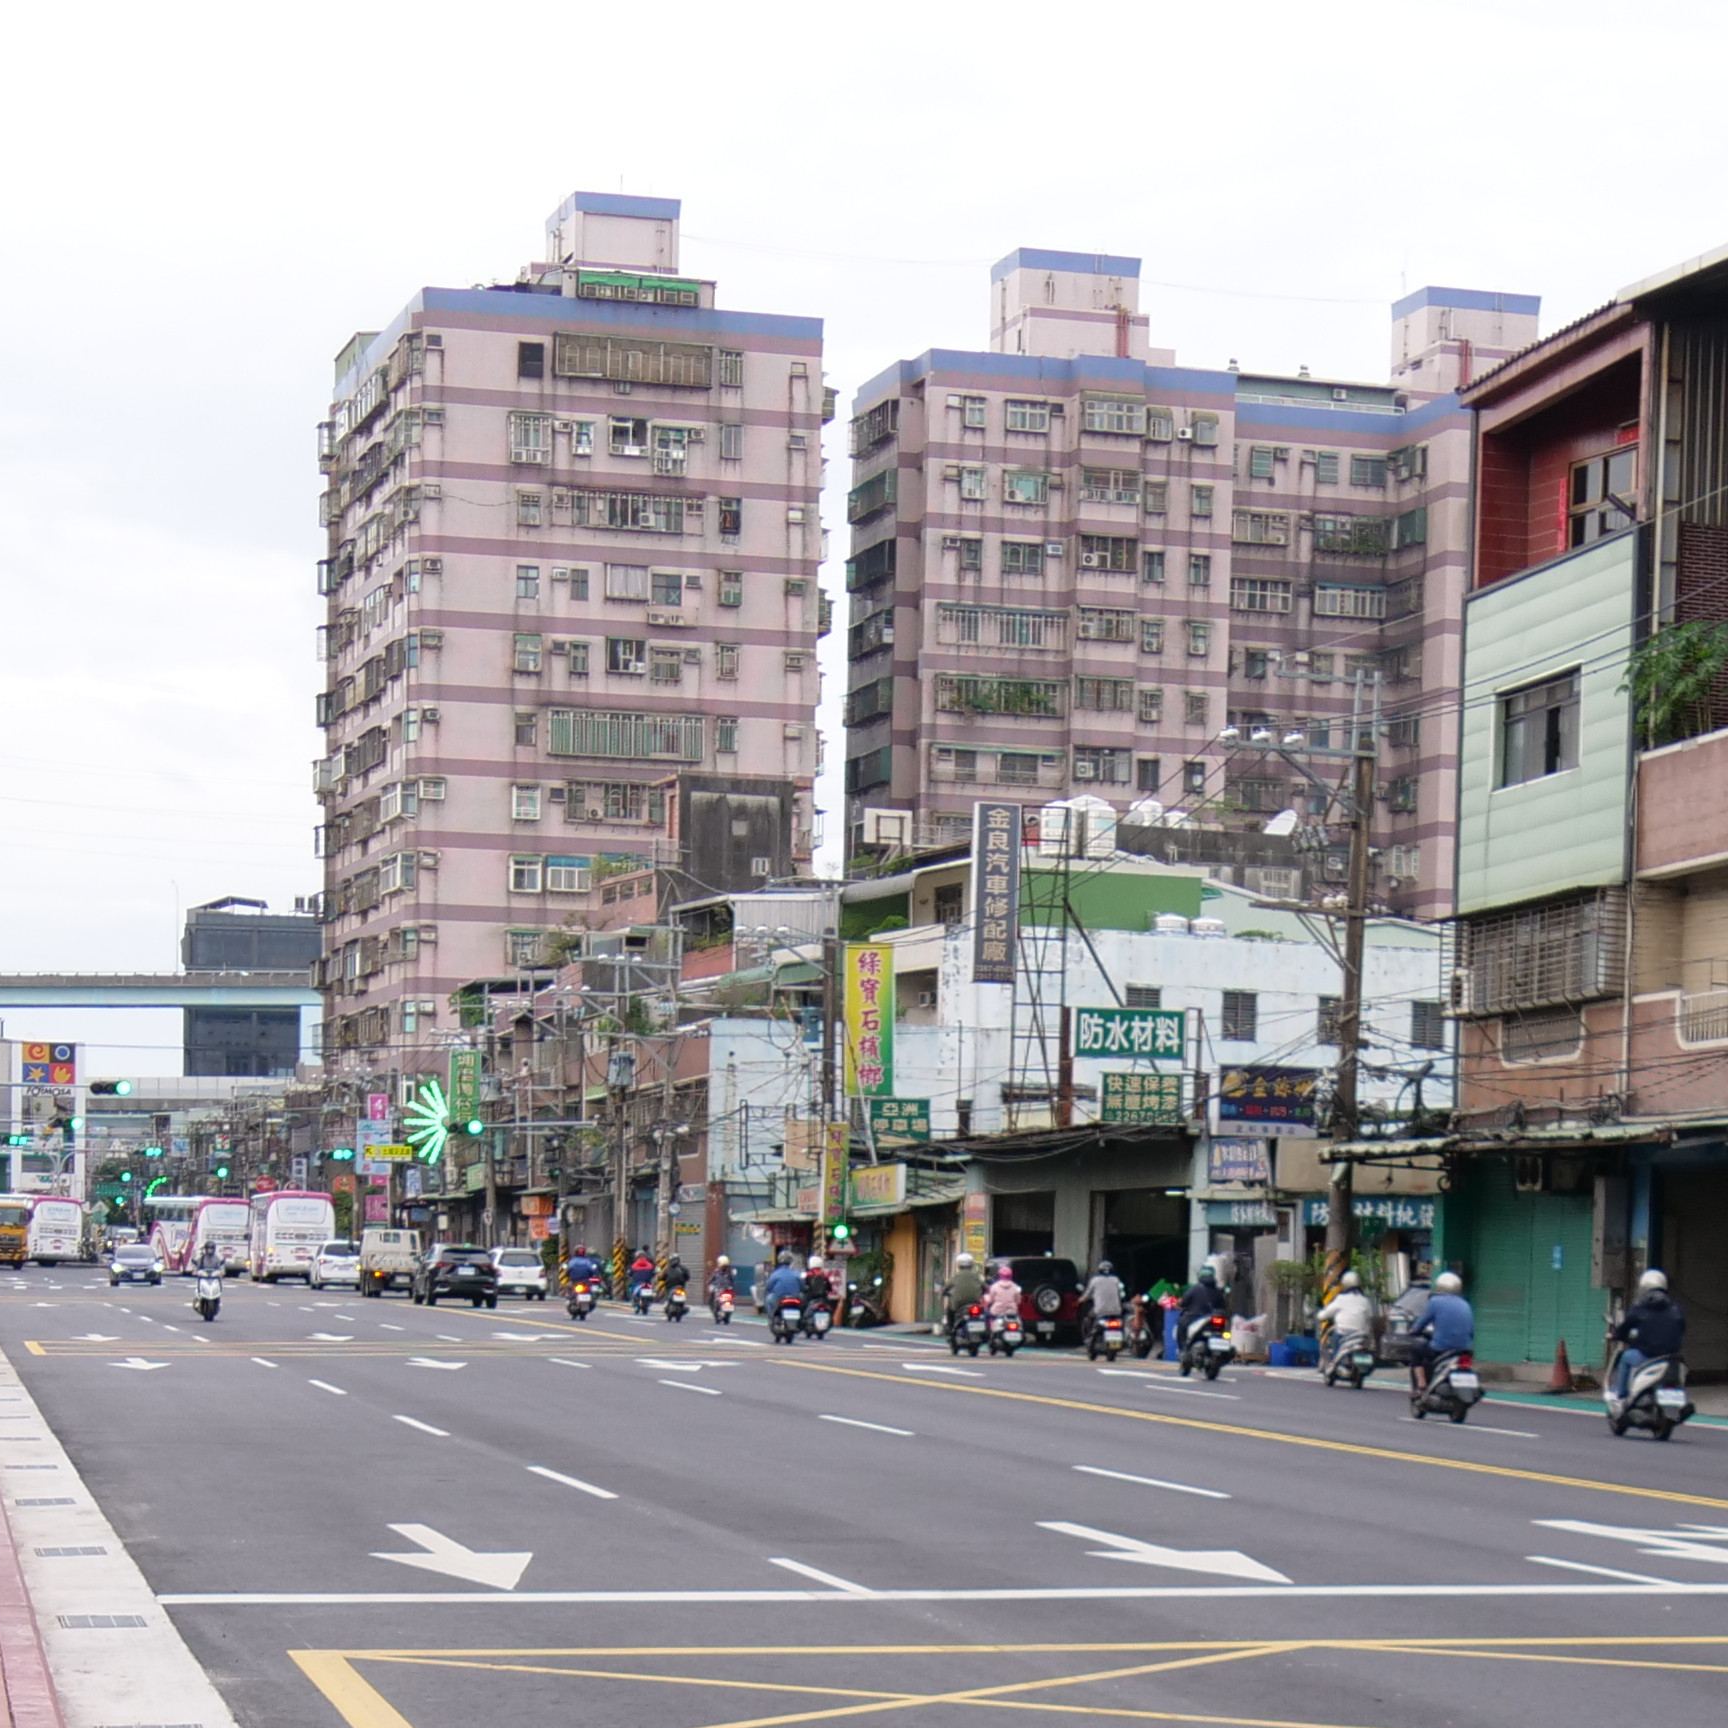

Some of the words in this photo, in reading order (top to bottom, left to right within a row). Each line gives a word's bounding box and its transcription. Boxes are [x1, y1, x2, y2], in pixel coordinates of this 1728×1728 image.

[982, 808, 1011, 962] 金良汽車修配廠
[1079, 1013, 1181, 1053] 防水材料
[26, 1087, 72, 1097] FORMOSA
[1107, 1075, 1177, 1093] 快速保養
[883, 1102, 919, 1116] 亞洲
[1312, 1199, 1434, 1228] 防材料批發
